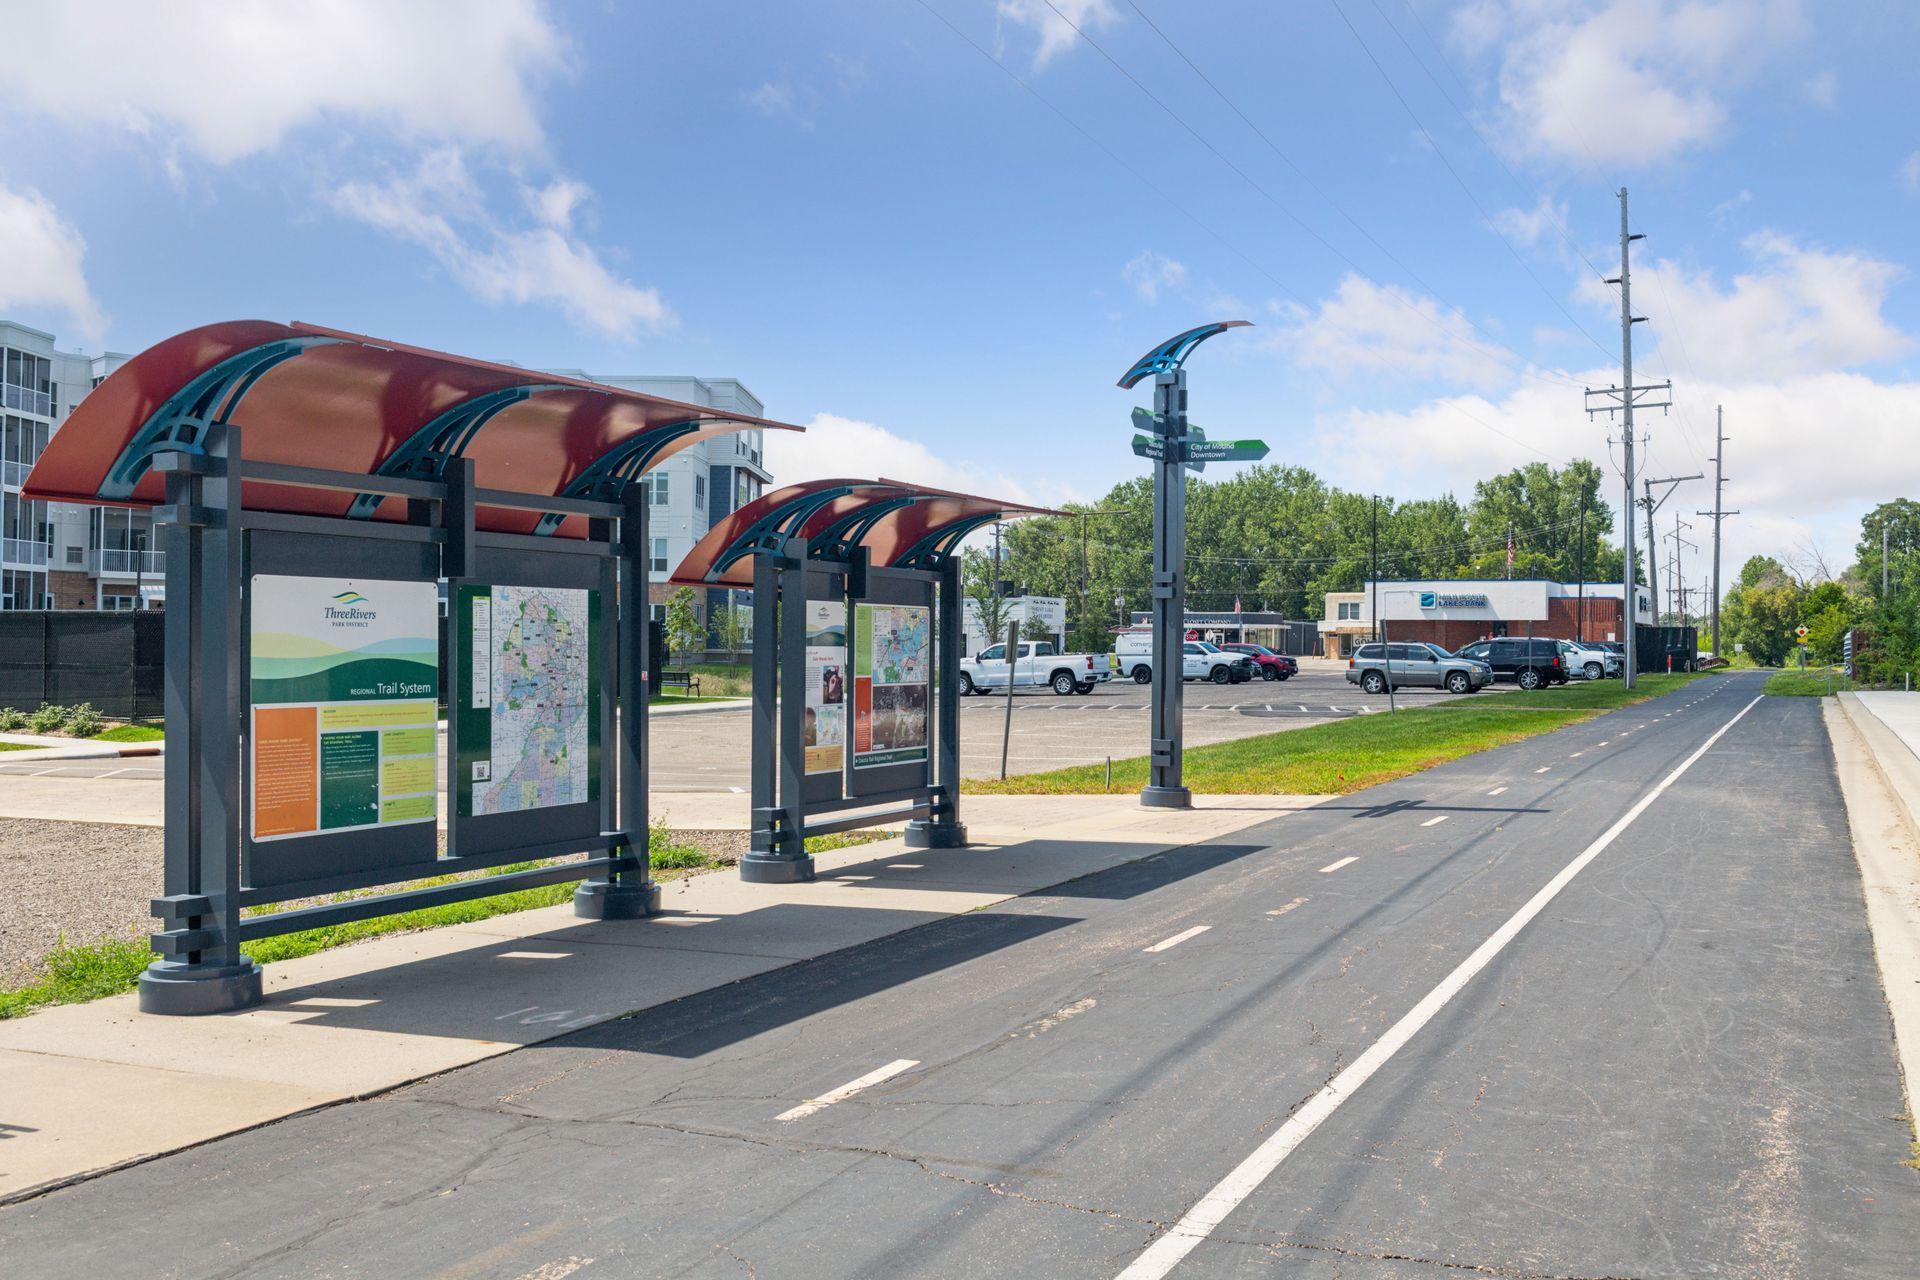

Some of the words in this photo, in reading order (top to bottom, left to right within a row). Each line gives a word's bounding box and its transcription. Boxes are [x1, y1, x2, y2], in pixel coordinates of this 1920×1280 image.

[1190, 443, 1203, 452] City
[1190, 451, 1226, 459] Downtown
[324, 607, 377, 619] ThreeRivers
[377, 682, 397, 694] Trail
[399, 682, 431, 696] System
